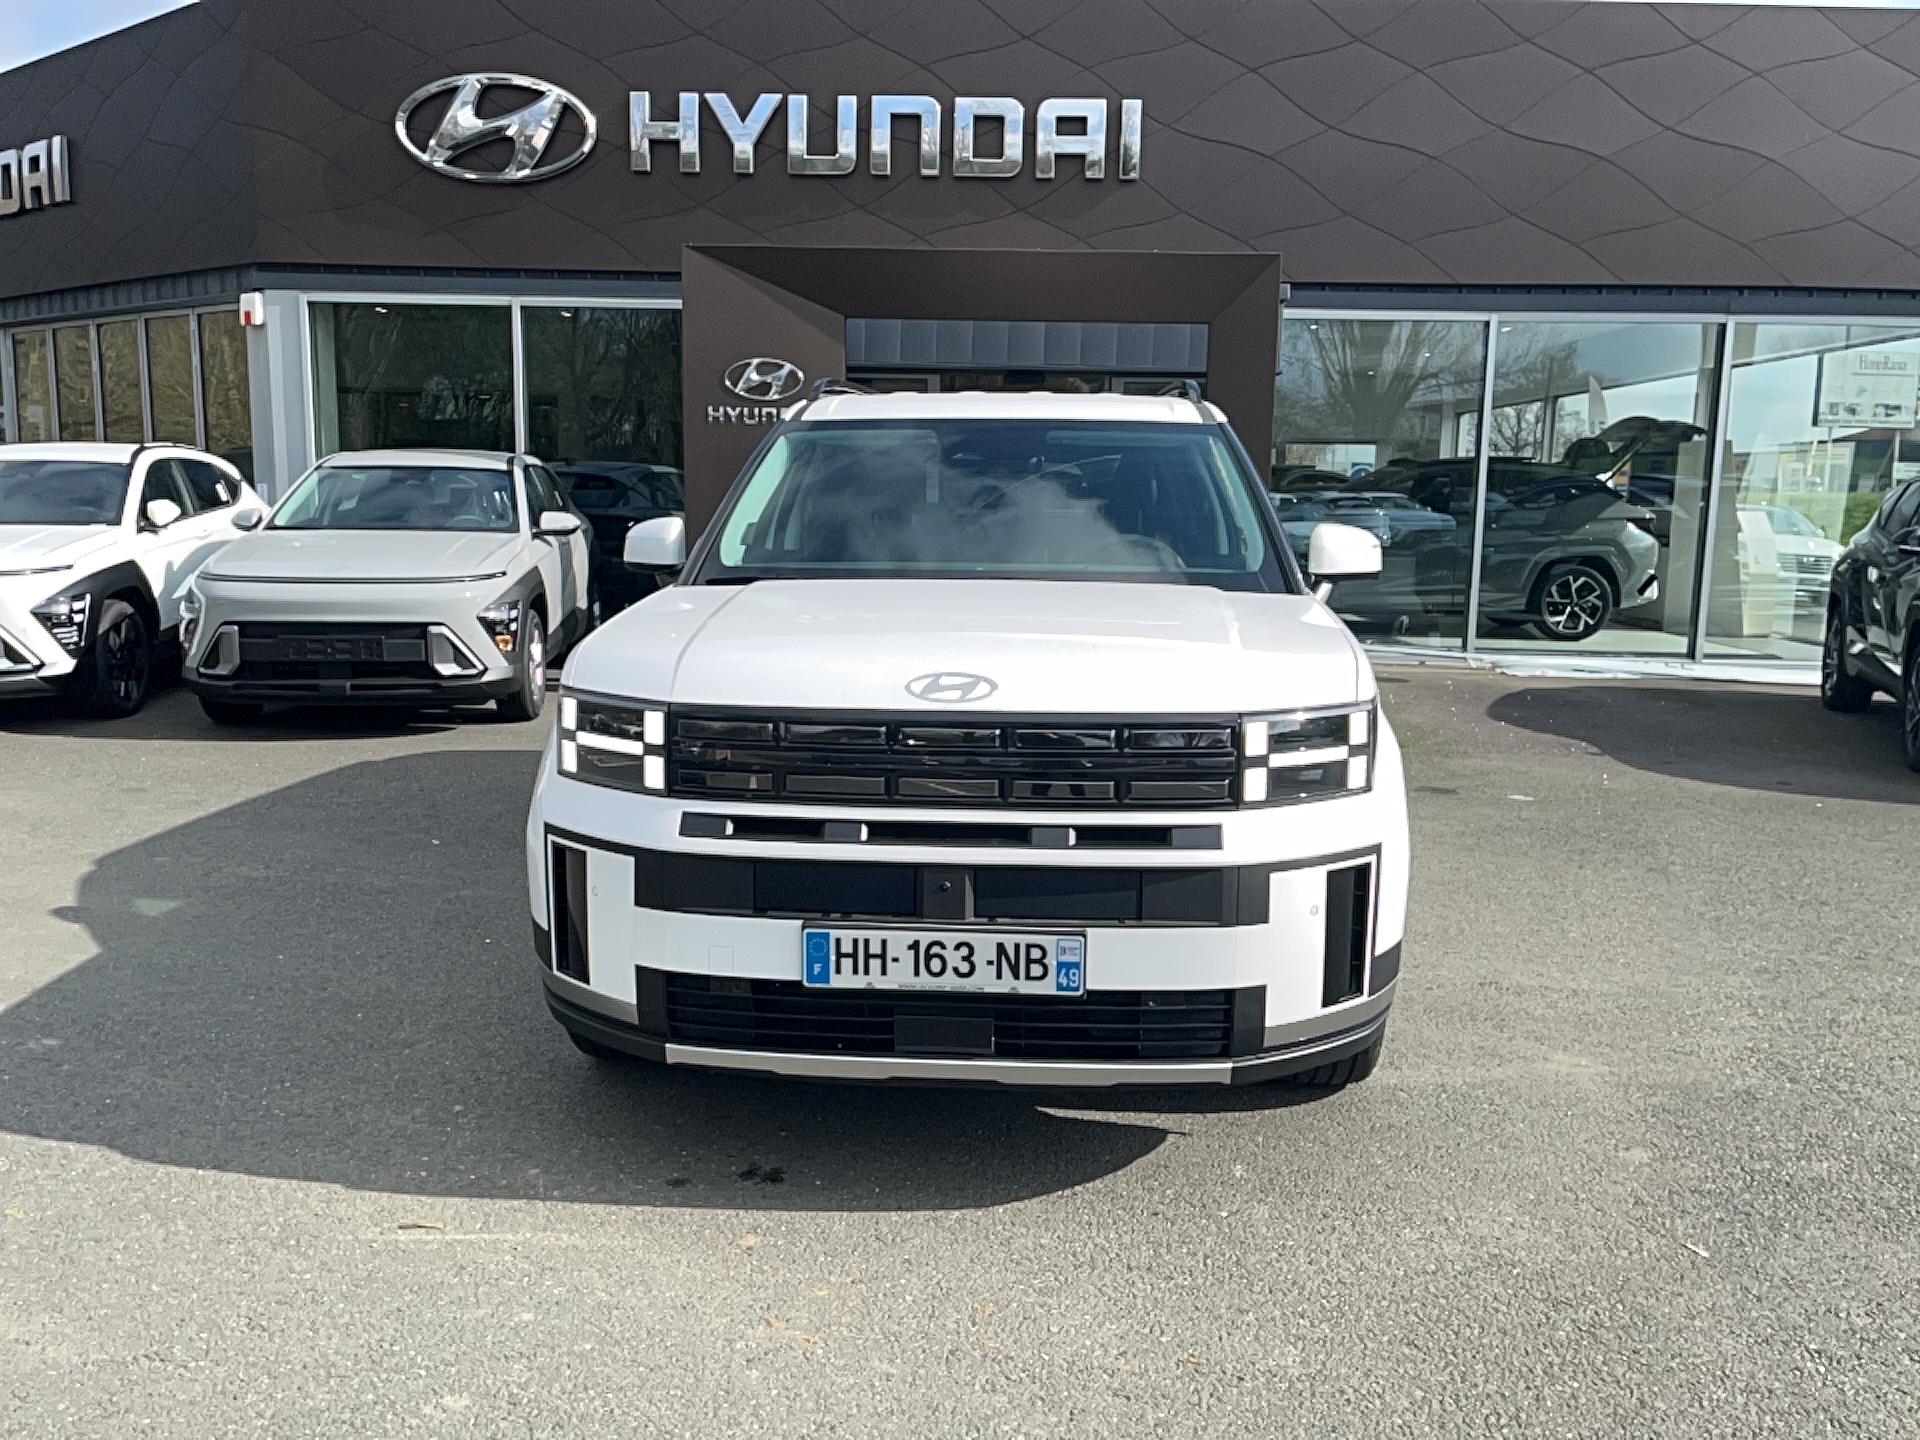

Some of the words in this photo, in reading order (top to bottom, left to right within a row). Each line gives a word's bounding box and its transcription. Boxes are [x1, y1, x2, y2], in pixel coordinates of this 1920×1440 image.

[629, 90, 1144, 180] HYUNDAI
[813, 963, 823, 975] F
[834, 937, 1049, 981] HH-163-NB
[1058, 967, 1080, 988] 49
